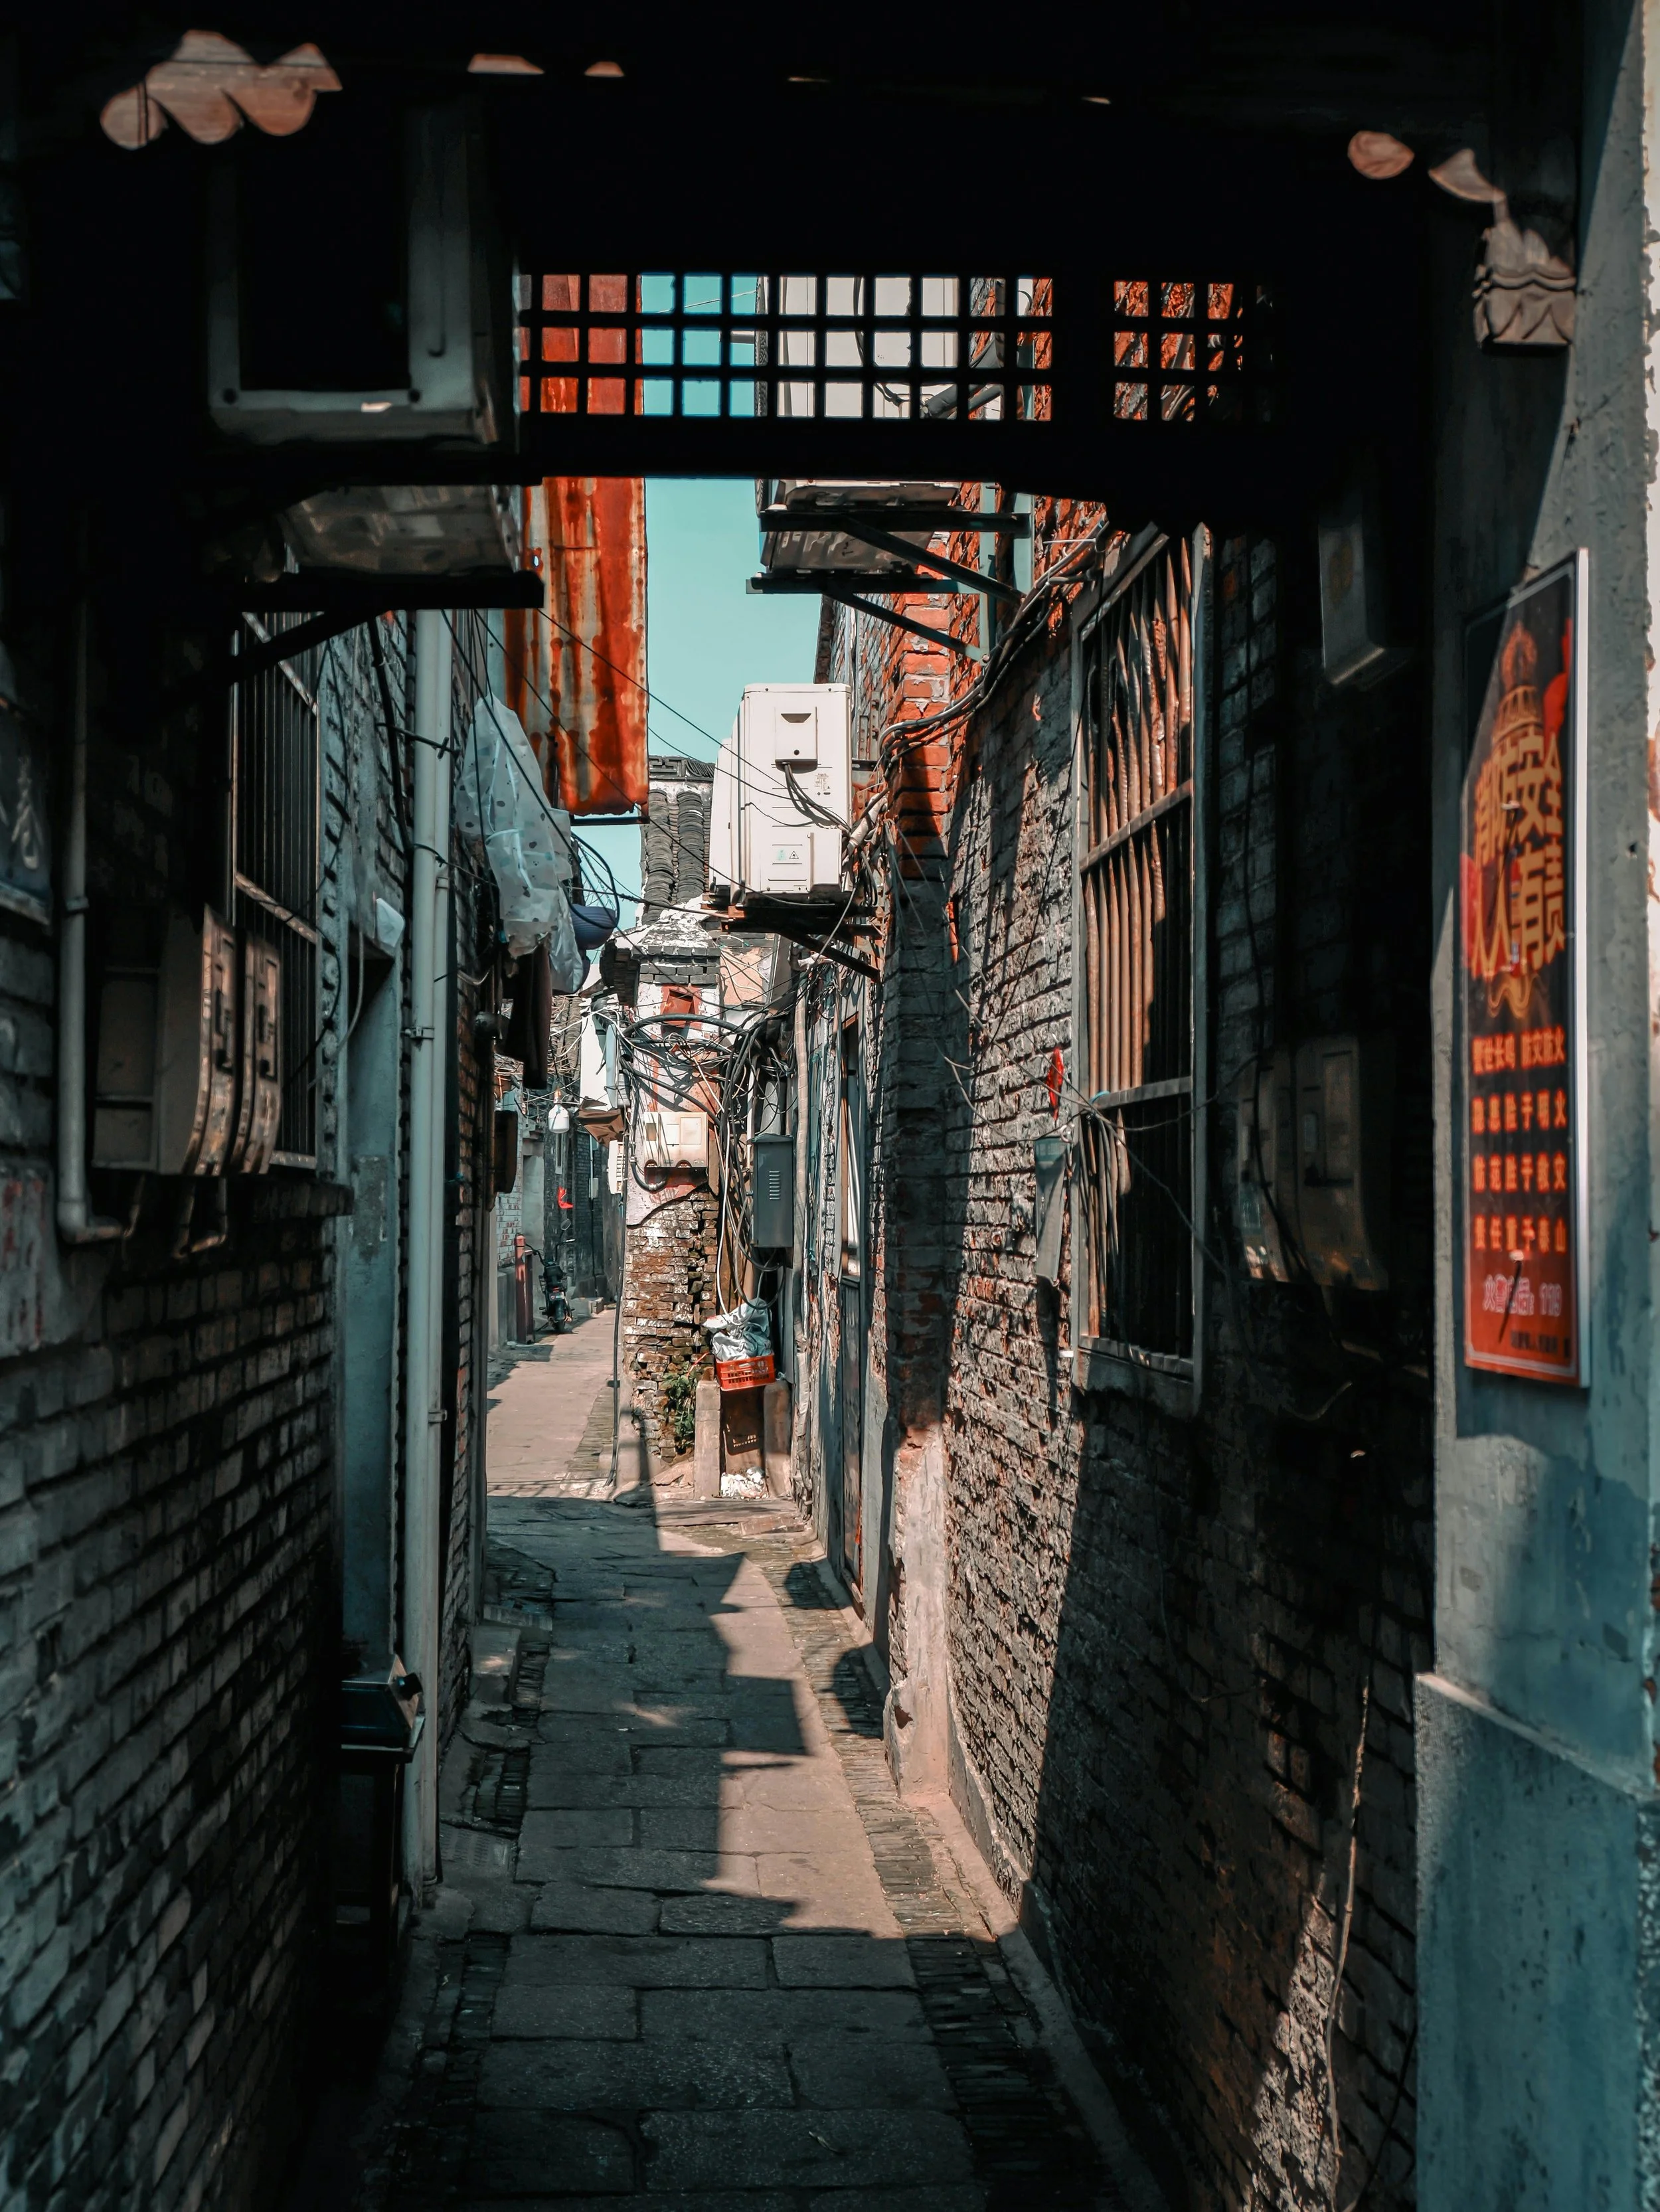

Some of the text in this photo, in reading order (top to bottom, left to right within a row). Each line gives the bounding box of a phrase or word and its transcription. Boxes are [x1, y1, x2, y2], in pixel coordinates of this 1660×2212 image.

[1471, 839, 1564, 979] 人人有责
[1539, 1282, 1562, 1316] 119
